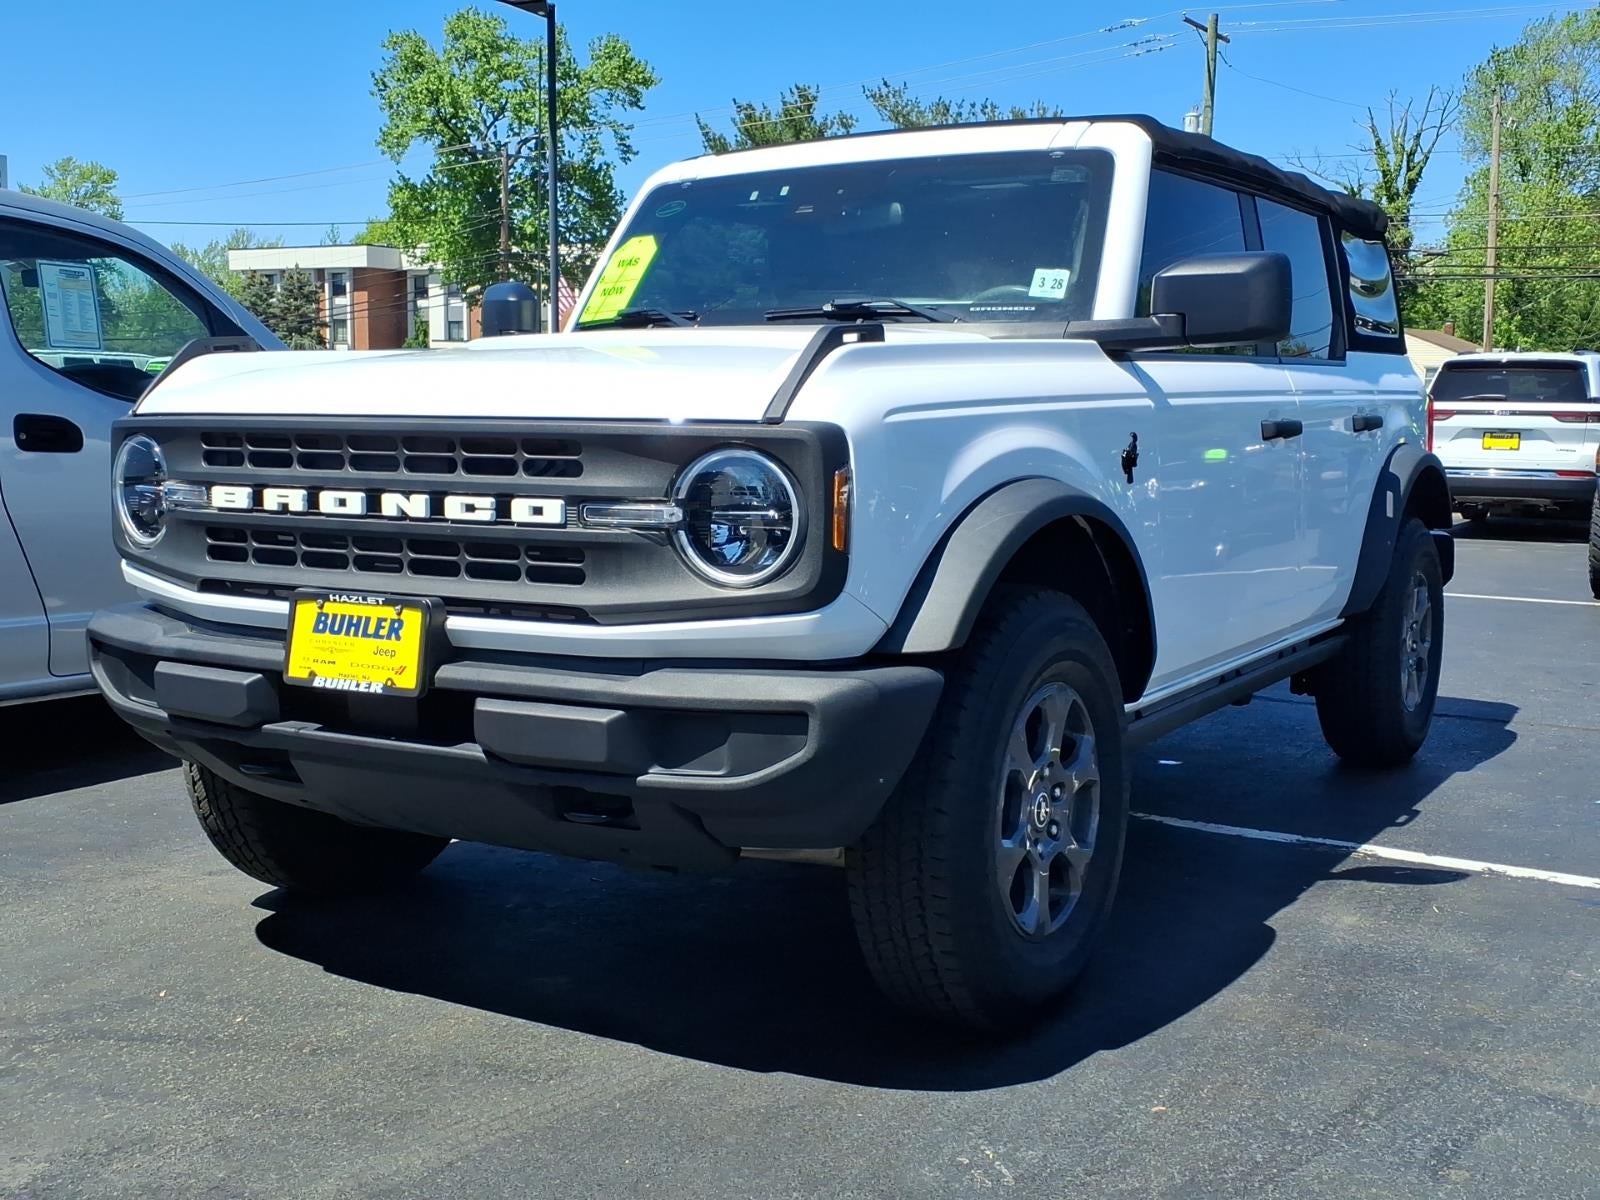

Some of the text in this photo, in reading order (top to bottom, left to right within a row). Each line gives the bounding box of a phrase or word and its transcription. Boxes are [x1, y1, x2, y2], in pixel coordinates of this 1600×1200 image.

[617, 256, 641, 268] WAS
[1038, 277, 1064, 290] 3 28
[600, 286, 625, 297] NOW
[211, 485, 566, 525] BRONCO
[329, 593, 386, 605] HAZLET
[312, 611, 405, 641] BUHLER
[373, 645, 397, 659] Jeep
[312, 676, 384, 694] BUHLER
